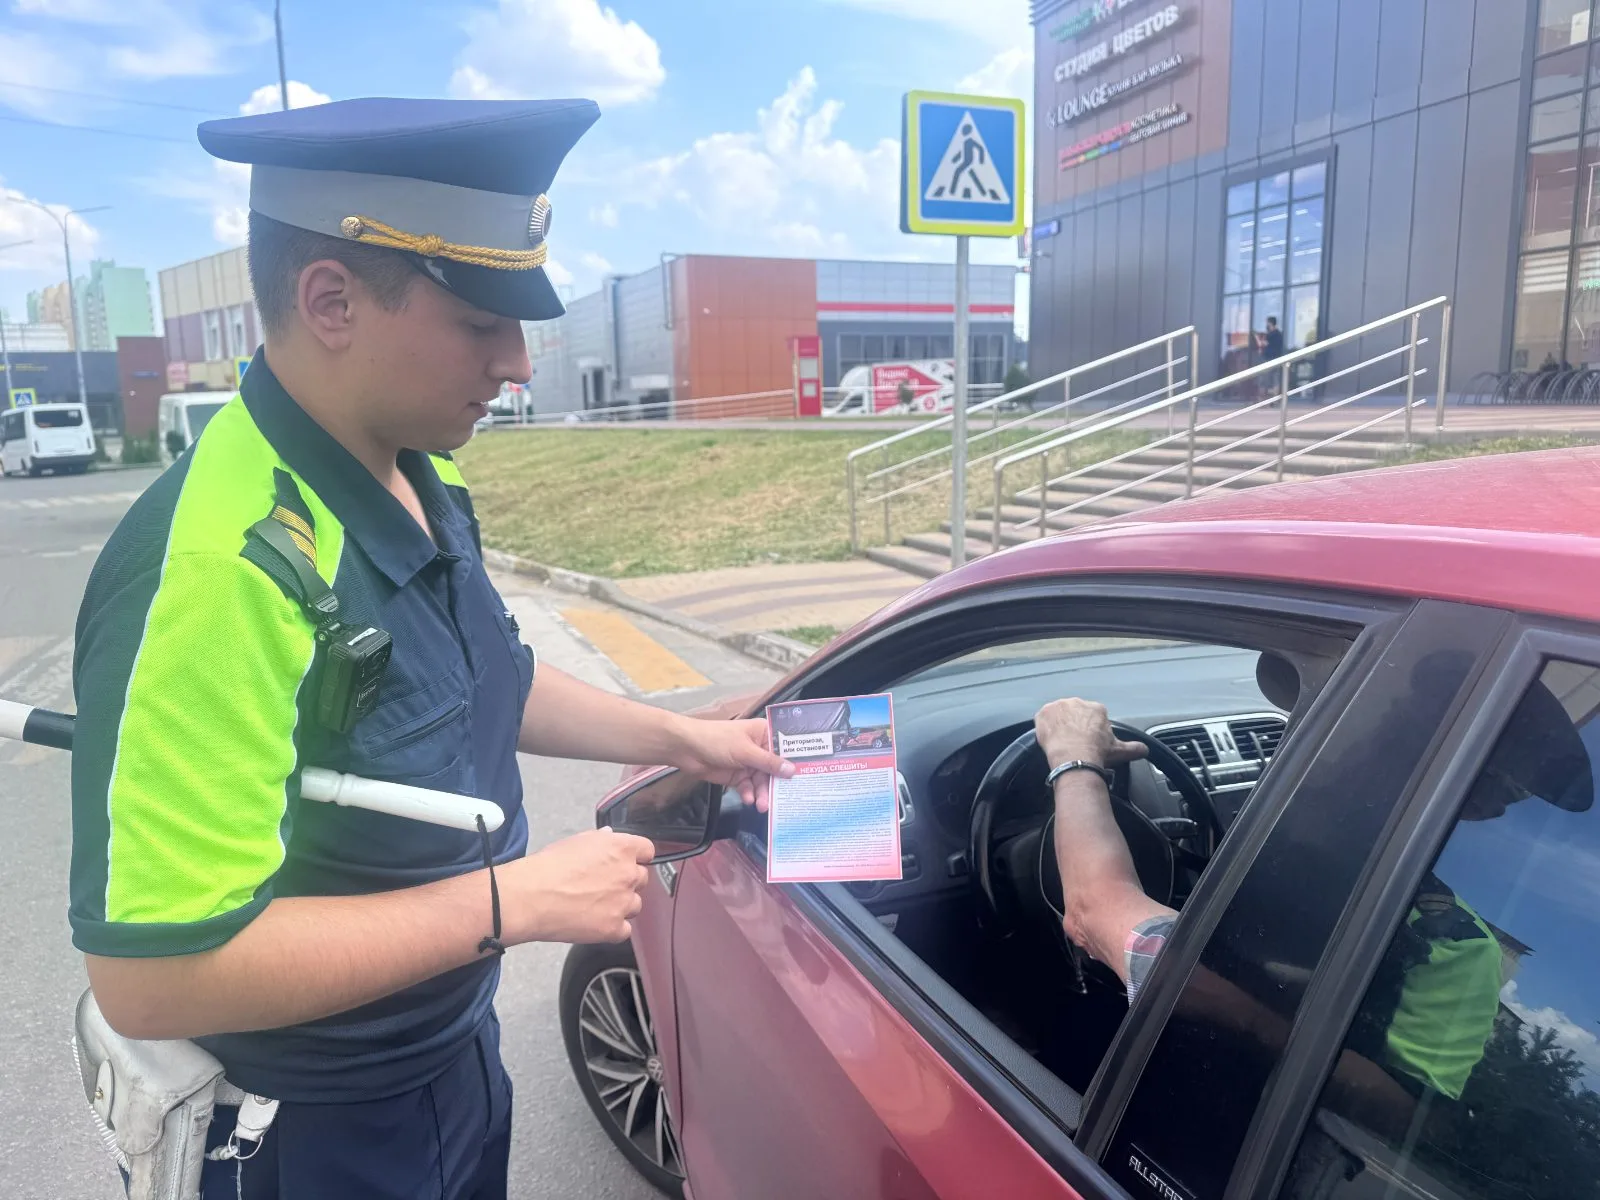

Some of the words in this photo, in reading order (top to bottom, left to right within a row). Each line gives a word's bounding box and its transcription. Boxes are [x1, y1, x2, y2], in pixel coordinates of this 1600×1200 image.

[1054, 42, 1109, 83] СТУДИЯ
[1112, 4, 1179, 54] ЦВЕТОВ
[1057, 83, 1108, 124] LOUNGE
[800, 764, 828, 774] НЕКУДА
